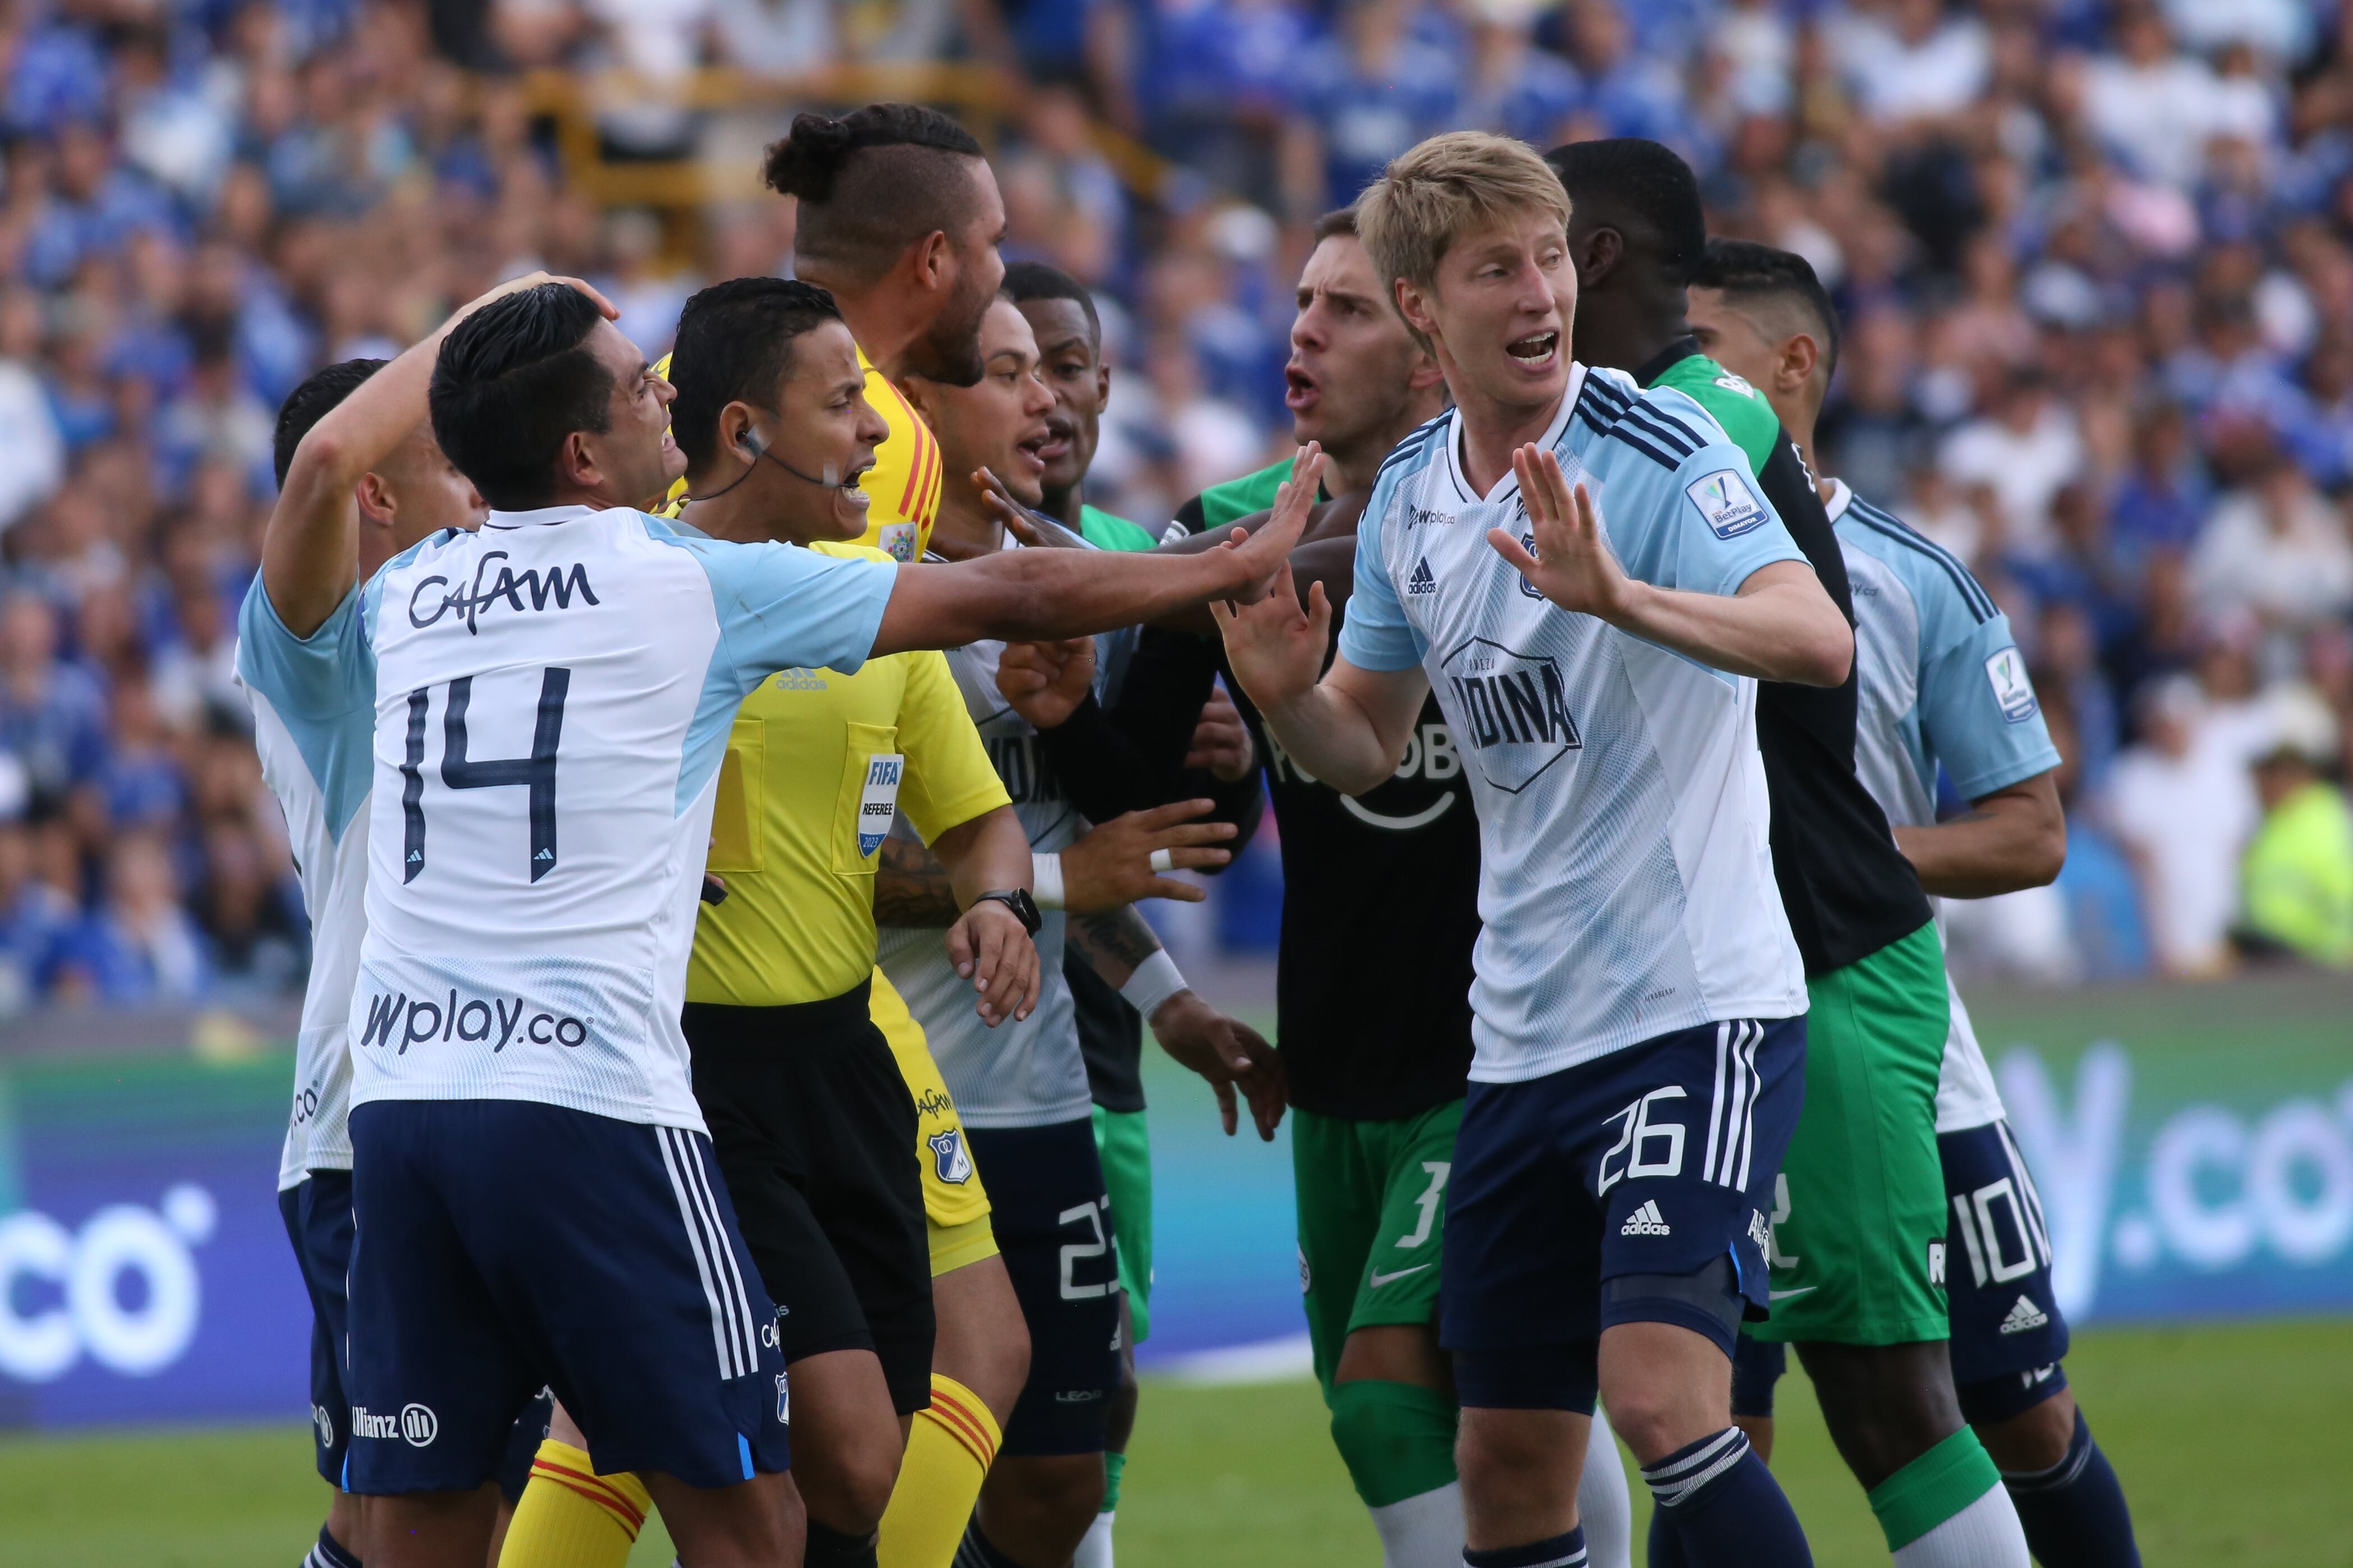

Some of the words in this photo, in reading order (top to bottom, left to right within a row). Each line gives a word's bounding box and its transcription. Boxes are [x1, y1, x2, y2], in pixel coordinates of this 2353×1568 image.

[1715, 504, 1751, 522] BetPlay
[1727, 517, 1758, 532] DIMAYOR
[1408, 582, 1436, 595] adidas
[776, 678, 828, 690] adidas
[398, 668, 571, 885] 14
[869, 762, 898, 785] FIFA
[863, 803, 893, 815] REFEREE
[863, 836, 879, 848] 2023
[1598, 1086, 1687, 1197] 26
[1621, 1221, 1670, 1235] adidas
[1953, 1177, 2037, 1289] 10
[1999, 1312, 2048, 1334] adidas
[352, 1405, 399, 1438] llianz
